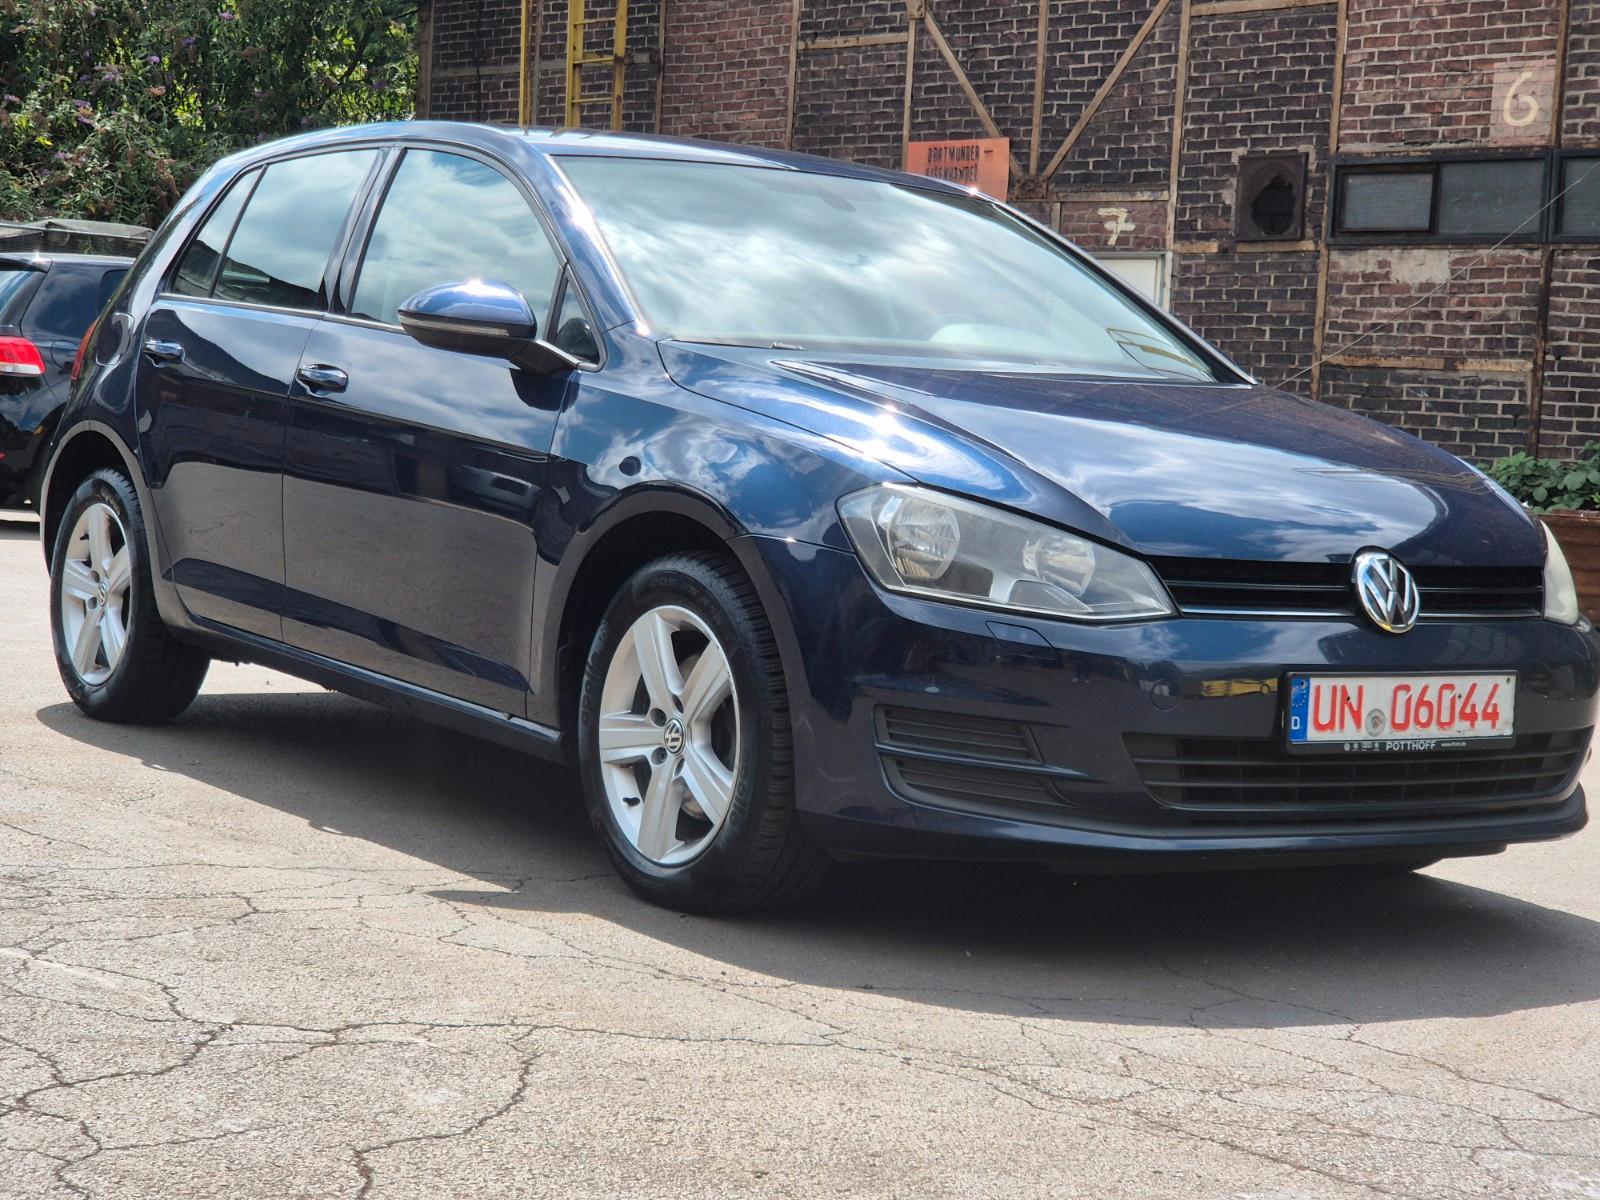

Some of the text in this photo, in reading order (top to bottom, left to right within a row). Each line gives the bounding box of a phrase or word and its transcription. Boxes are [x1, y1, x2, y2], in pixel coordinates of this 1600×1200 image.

[1503, 72, 1538, 127] 6
[1097, 207, 1136, 246] 7
[1290, 715, 1301, 730] D
[1313, 683, 1500, 731] UN 06044
[1385, 740, 1437, 751] POTTHOFF
